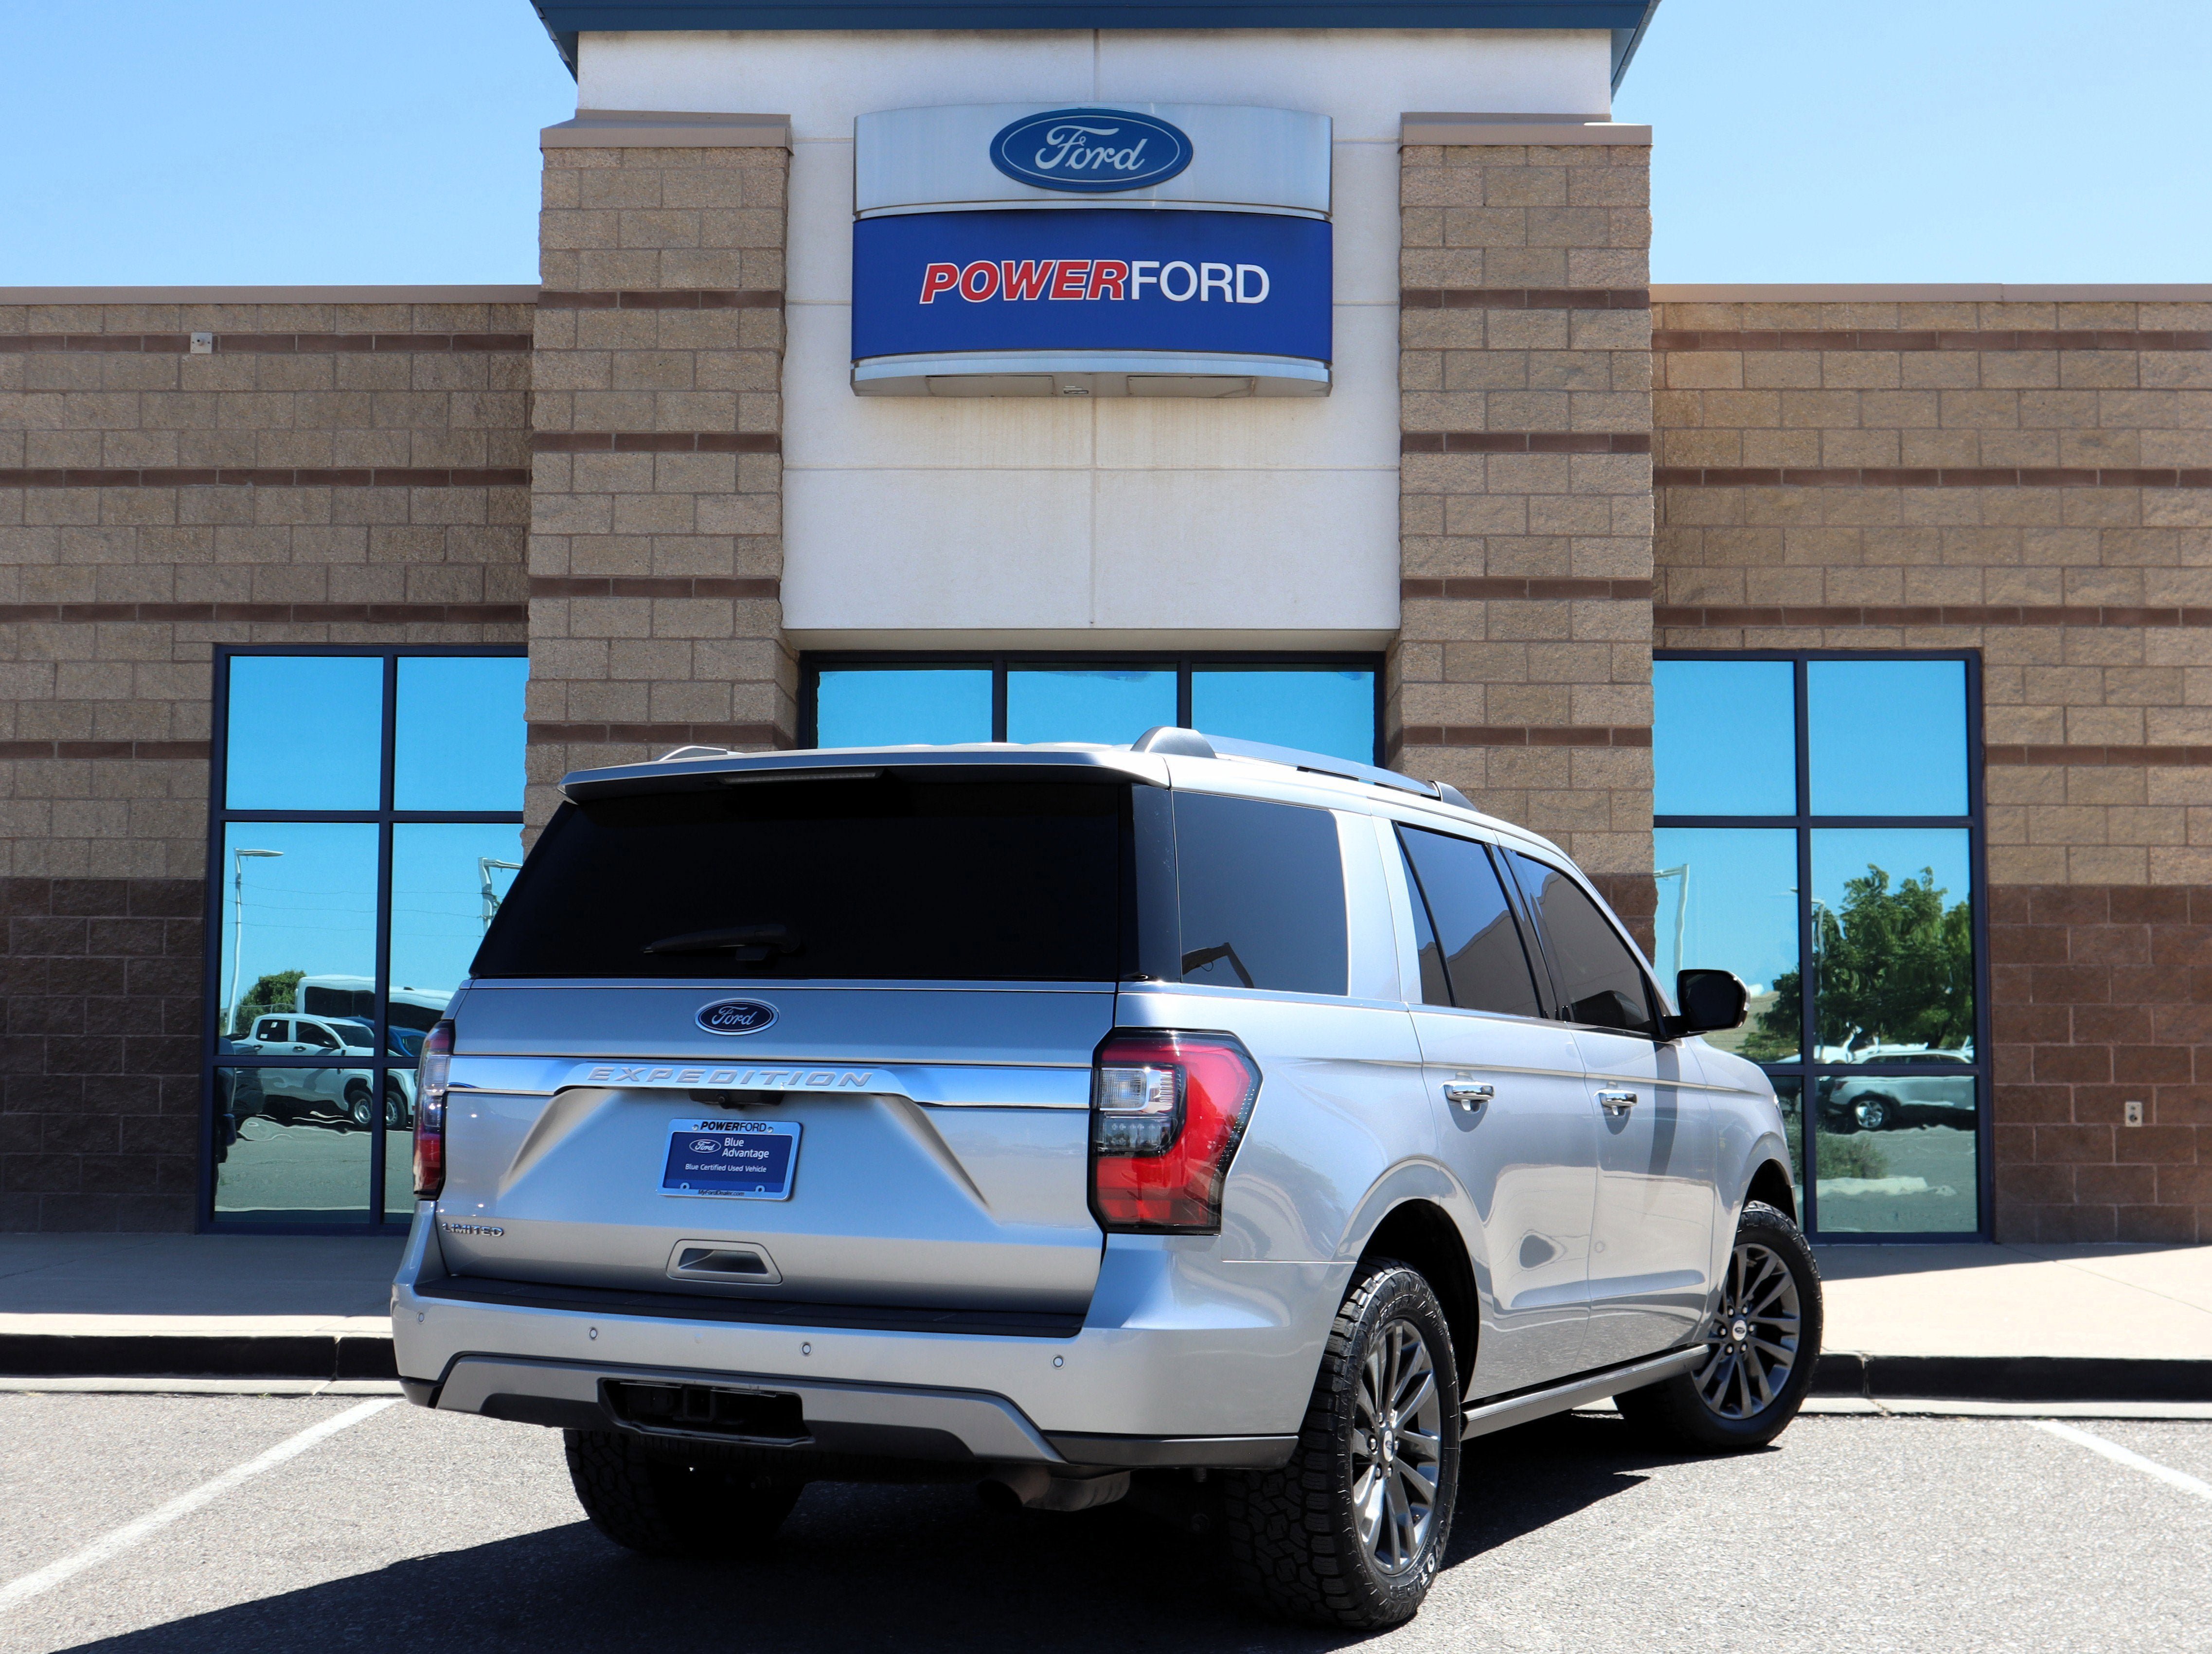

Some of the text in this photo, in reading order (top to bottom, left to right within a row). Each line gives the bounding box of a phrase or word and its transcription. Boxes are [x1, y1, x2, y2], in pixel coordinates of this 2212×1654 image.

[1034, 125, 1148, 172] Ford
[919, 260, 1270, 305] POWERFORD
[712, 1006, 754, 1026] Ford
[587, 1067, 873, 1087] EXPEDITION
[700, 1121, 767, 1132] POWERFORD
[695, 1141, 714, 1151] Ford
[724, 1138, 744, 1147] Blue
[722, 1148, 769, 1159] Advantage
[442, 1222, 504, 1237] LIMITED
